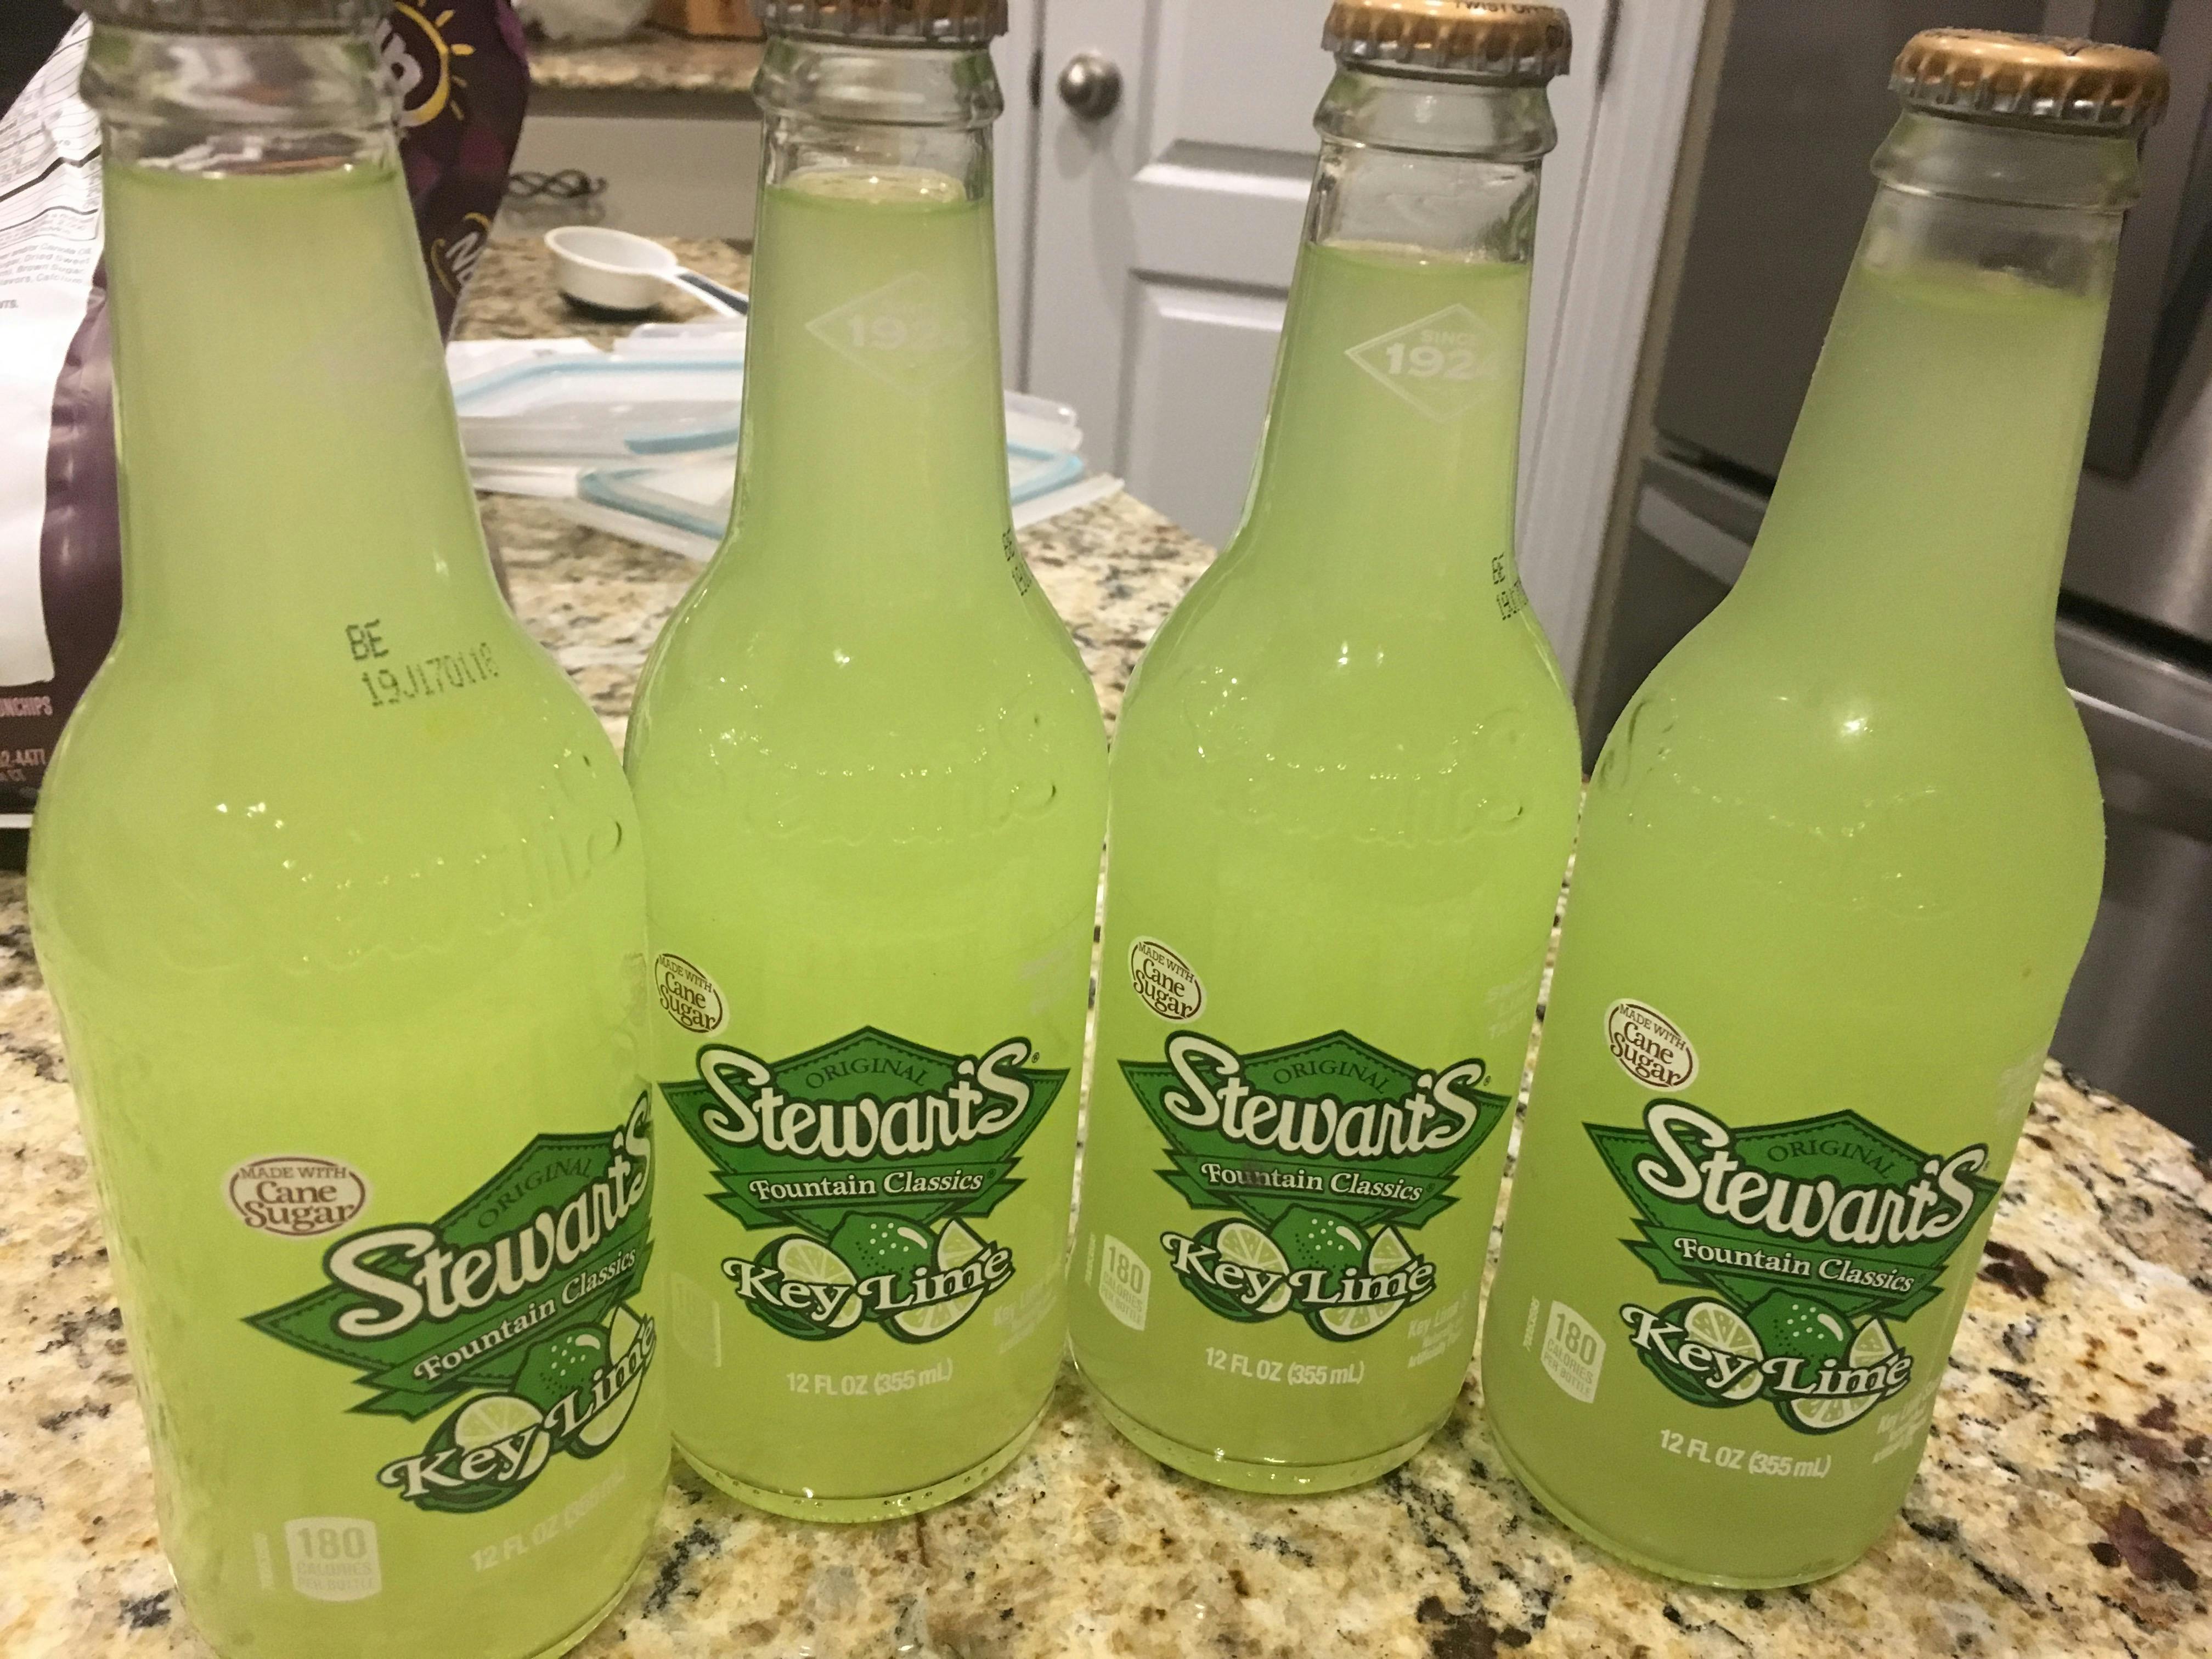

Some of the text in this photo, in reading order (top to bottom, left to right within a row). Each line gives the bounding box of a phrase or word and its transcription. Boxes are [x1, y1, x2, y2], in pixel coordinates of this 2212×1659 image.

[346, 619, 388, 660] BE
[1139, 941, 1194, 984] MADE WITH
[1143, 958, 1185, 997] Cane
[660, 984, 716, 1031] Sugar
[665, 972, 706, 1009] Cane
[1133, 969, 1193, 1019] Sugar
[1620, 1003, 1687, 1051] MADE WITH
[1624, 1021, 1674, 1064] Cane
[805, 1057, 928, 1089] ORIGINAL
[1273, 1060, 1390, 1094] ORIGINAL
[1610, 1031, 1681, 1087] Sugar
[239, 1166, 347, 1180] MADE WITH
[1768, 1139, 1895, 1180] ORIGINAL
[256, 1180, 338, 1205] Cane
[477, 1156, 592, 1229] ORIGINAL
[749, 1170, 984, 1200] Fountain Classics
[1200, 1164, 1423, 1201] Fountain Classics
[244, 1200, 355, 1232] Sugar
[1109, 1246, 1144, 1294] 180
[1161, 1232, 1288, 1303] Key
[1674, 1237, 1915, 1293] Fountain Classics
[723, 1258, 850, 1320] Key
[413, 1246, 636, 1382] Fountain Classics
[1547, 1338, 1593, 1384] CALORIES
[1555, 1313, 1598, 1366] 180
[1622, 1305, 1757, 1391] Key
[787, 1372, 809, 1393] 12
[815, 1375, 839, 1395] FL
[842, 1374, 868, 1396] OZ
[873, 1368, 916, 1396] (355
[1205, 1347, 1226, 1369] 12
[1230, 1356, 1253, 1378] FL
[1256, 1359, 1282, 1382] OZ
[1287, 1361, 1327, 1386] (355
[379, 1425, 543, 1499] Key
[1660, 1429, 1682, 1454] 12
[1686, 1439, 1711, 1464] FL
[1715, 1447, 1744, 1471] OZ
[1748, 1451, 1792, 1477] (355
[298, 1527, 368, 1559] 180
